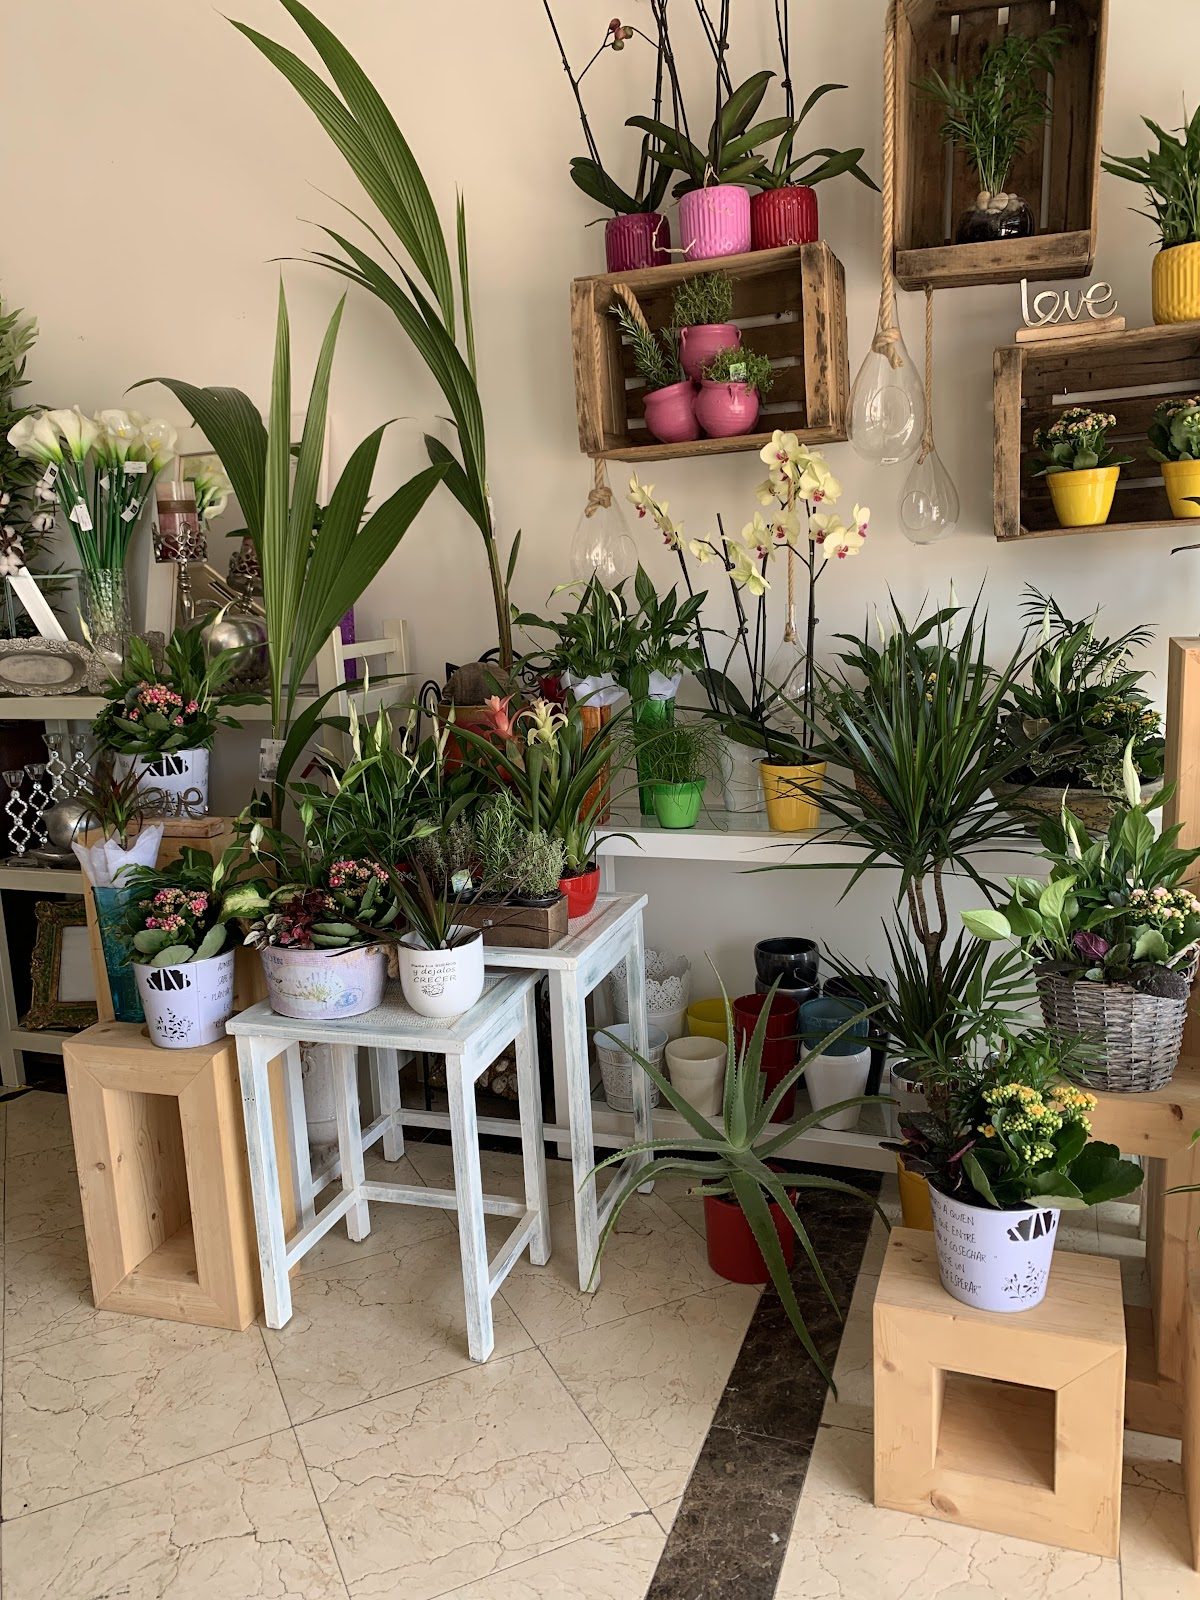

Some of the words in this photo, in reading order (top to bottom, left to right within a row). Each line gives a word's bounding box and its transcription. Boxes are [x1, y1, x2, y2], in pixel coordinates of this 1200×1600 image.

[137, 786, 209, 821] ove
[413, 974, 457, 984] CRECER
[949, 1209, 975, 1226] QUIEN
[951, 1226, 977, 1244] ENTRE
[949, 1240, 987, 1264] COSECHAR
